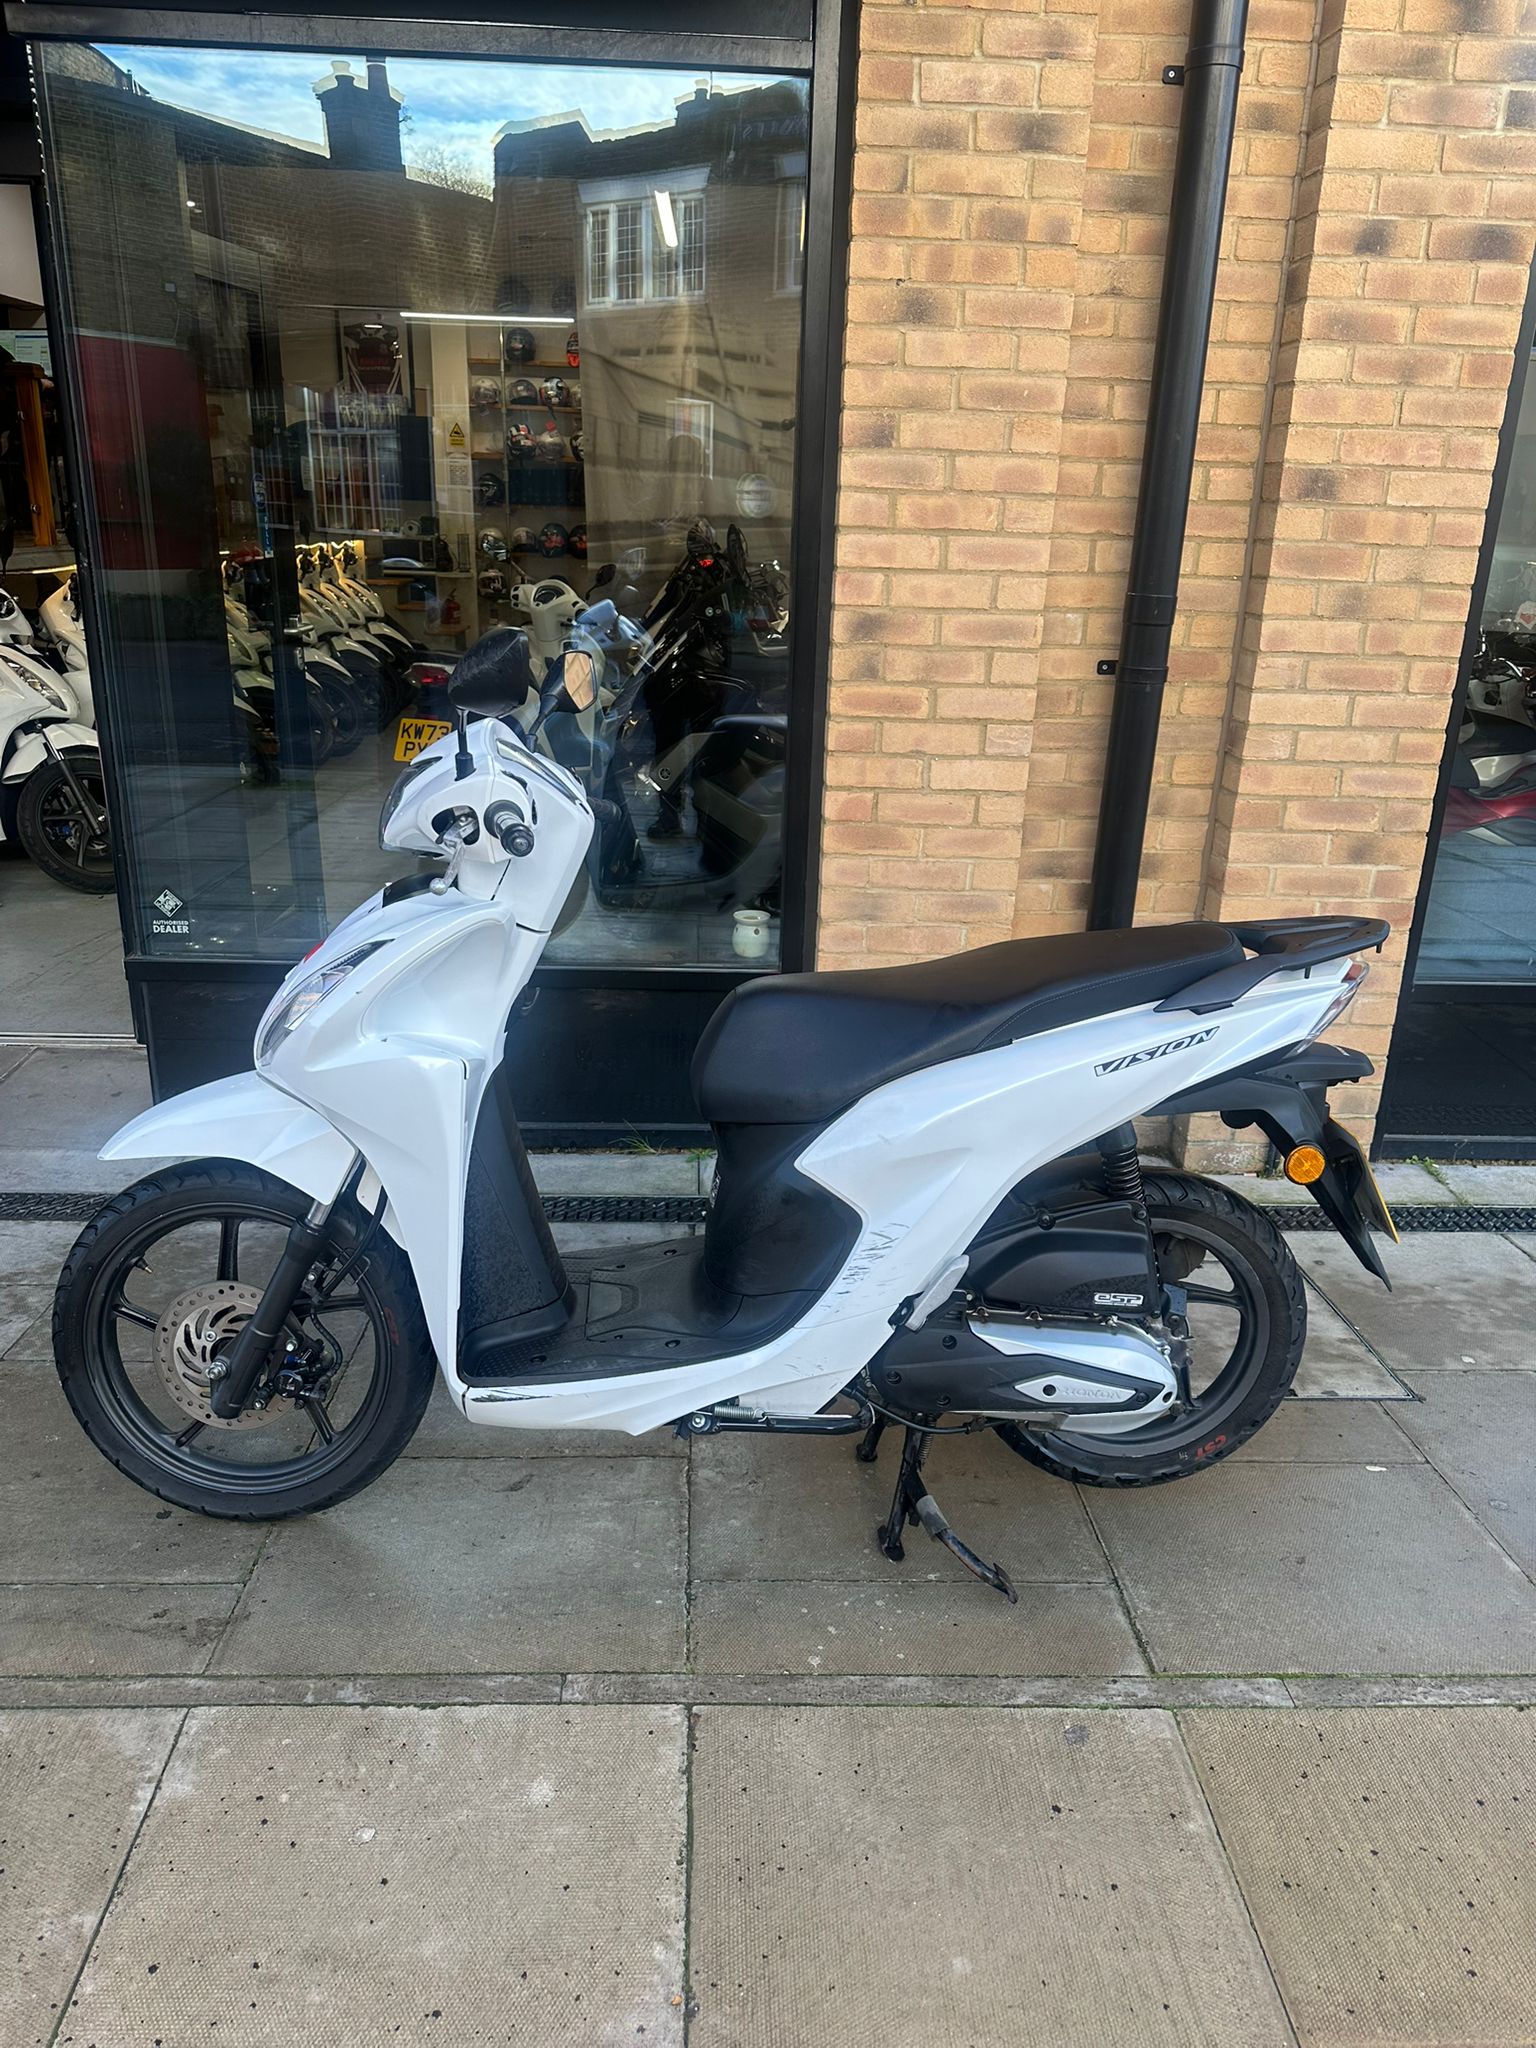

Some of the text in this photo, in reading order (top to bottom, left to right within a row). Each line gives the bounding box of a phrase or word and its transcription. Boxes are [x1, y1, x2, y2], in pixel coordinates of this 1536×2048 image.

[401, 722, 450, 742] KW73
[403, 741, 430, 757] PY
[153, 925, 190, 934] DEALER
[1094, 1026, 1219, 1077] VISION
[1060, 1386, 1122, 1400] HONDA
[1195, 1434, 1227, 1461] CST
